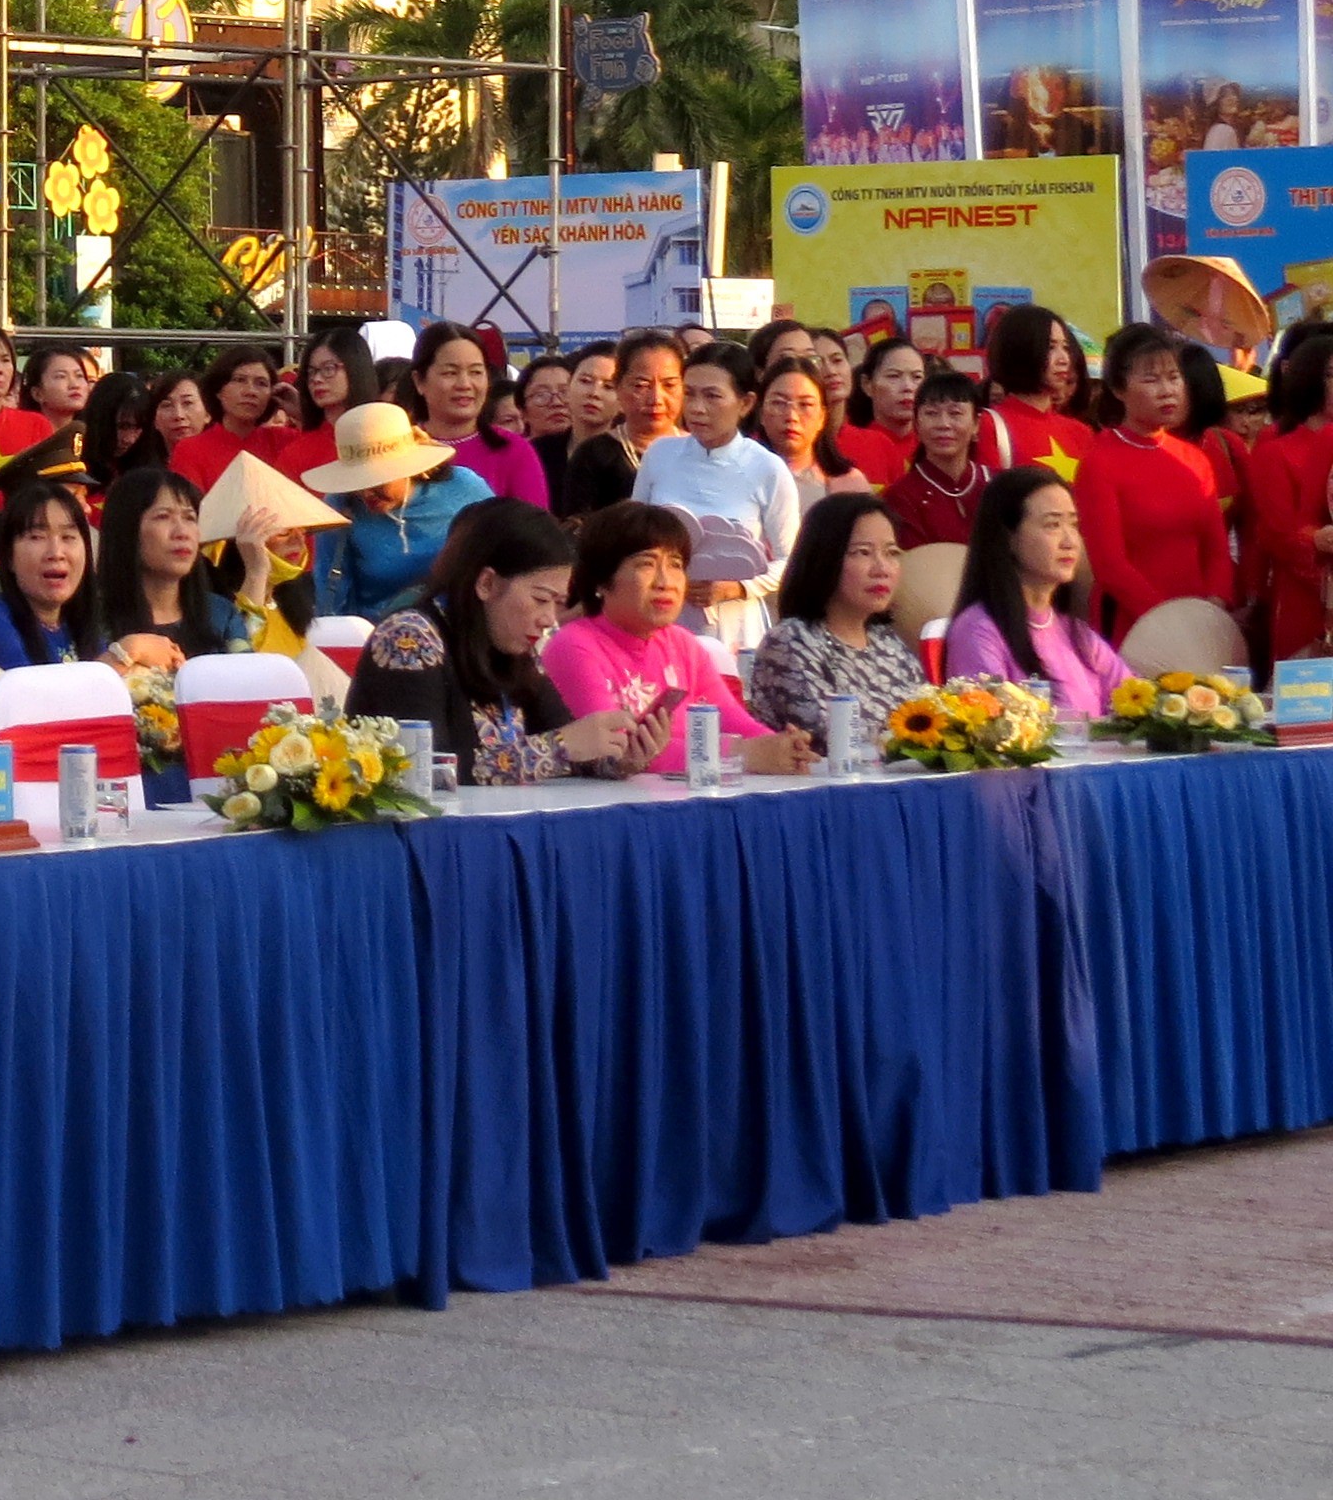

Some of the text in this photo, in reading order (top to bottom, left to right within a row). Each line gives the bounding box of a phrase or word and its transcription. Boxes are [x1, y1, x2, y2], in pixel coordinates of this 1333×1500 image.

[457, 196, 498, 218] CÔNG
[501, 201, 519, 218] TY
[565, 198, 599, 215] MTV
[602, 192, 633, 213] NHÀ
[638, 190, 682, 212] HÀNG
[861, 188, 873, 199] TY
[876, 187, 903, 199] TNHH
[905, 186, 928, 198] MTV
[884, 205, 1038, 230] NAFINEST
[491, 222, 520, 244] YẾN
[558, 221, 609, 242] KHÁNH
[613, 219, 646, 240] HÒA
